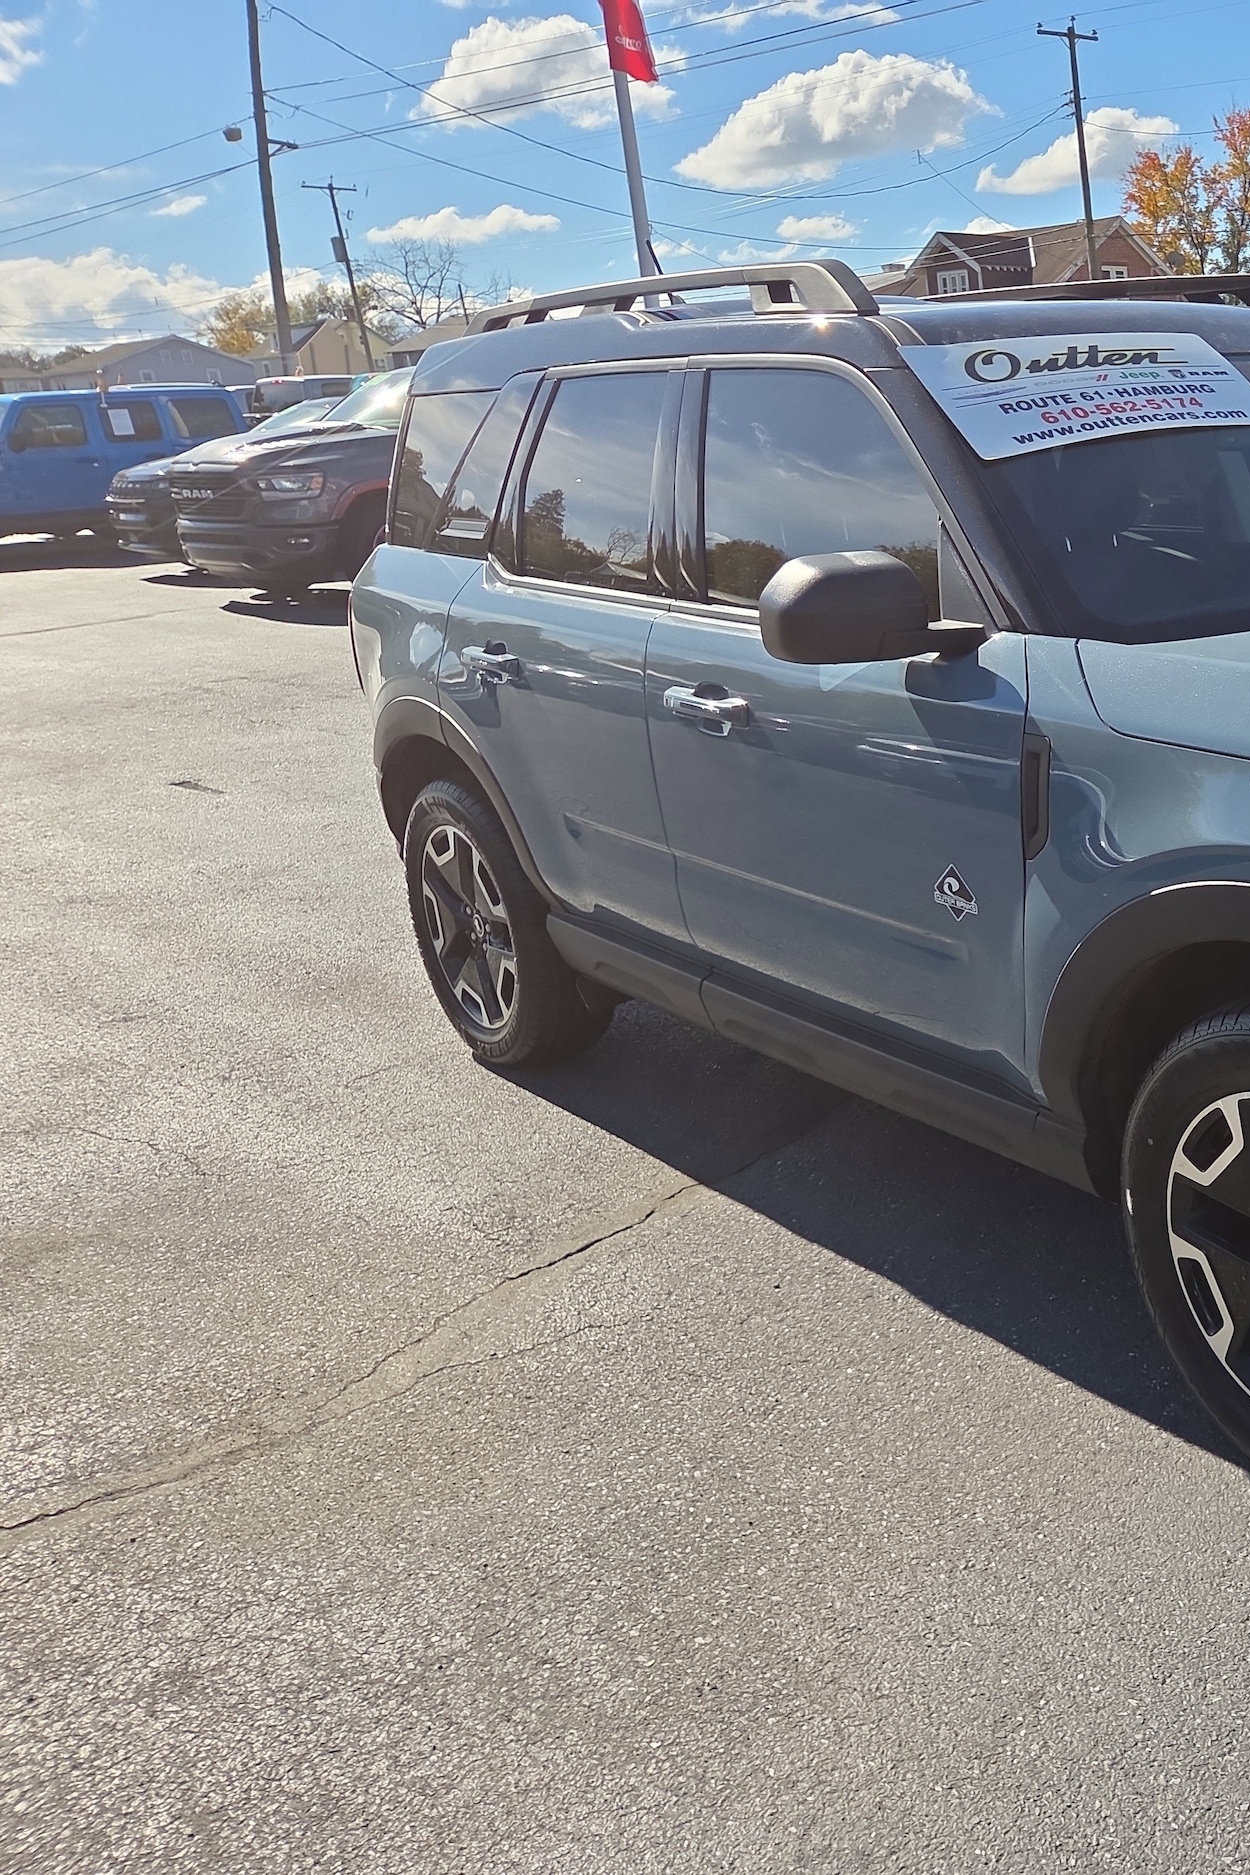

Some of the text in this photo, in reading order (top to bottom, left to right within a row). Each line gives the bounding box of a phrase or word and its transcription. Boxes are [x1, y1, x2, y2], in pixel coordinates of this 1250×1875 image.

[964, 345, 1189, 383] Outten
[1119, 371, 1161, 380] Jeep
[999, 393, 1077, 414] ROUTE
[1114, 384, 1217, 398] HAMBURG
[1041, 397, 1204, 424] 610-562-5174
[1012, 410, 1248, 444] www.outtencars.com
[181, 489, 213, 499] RAM
